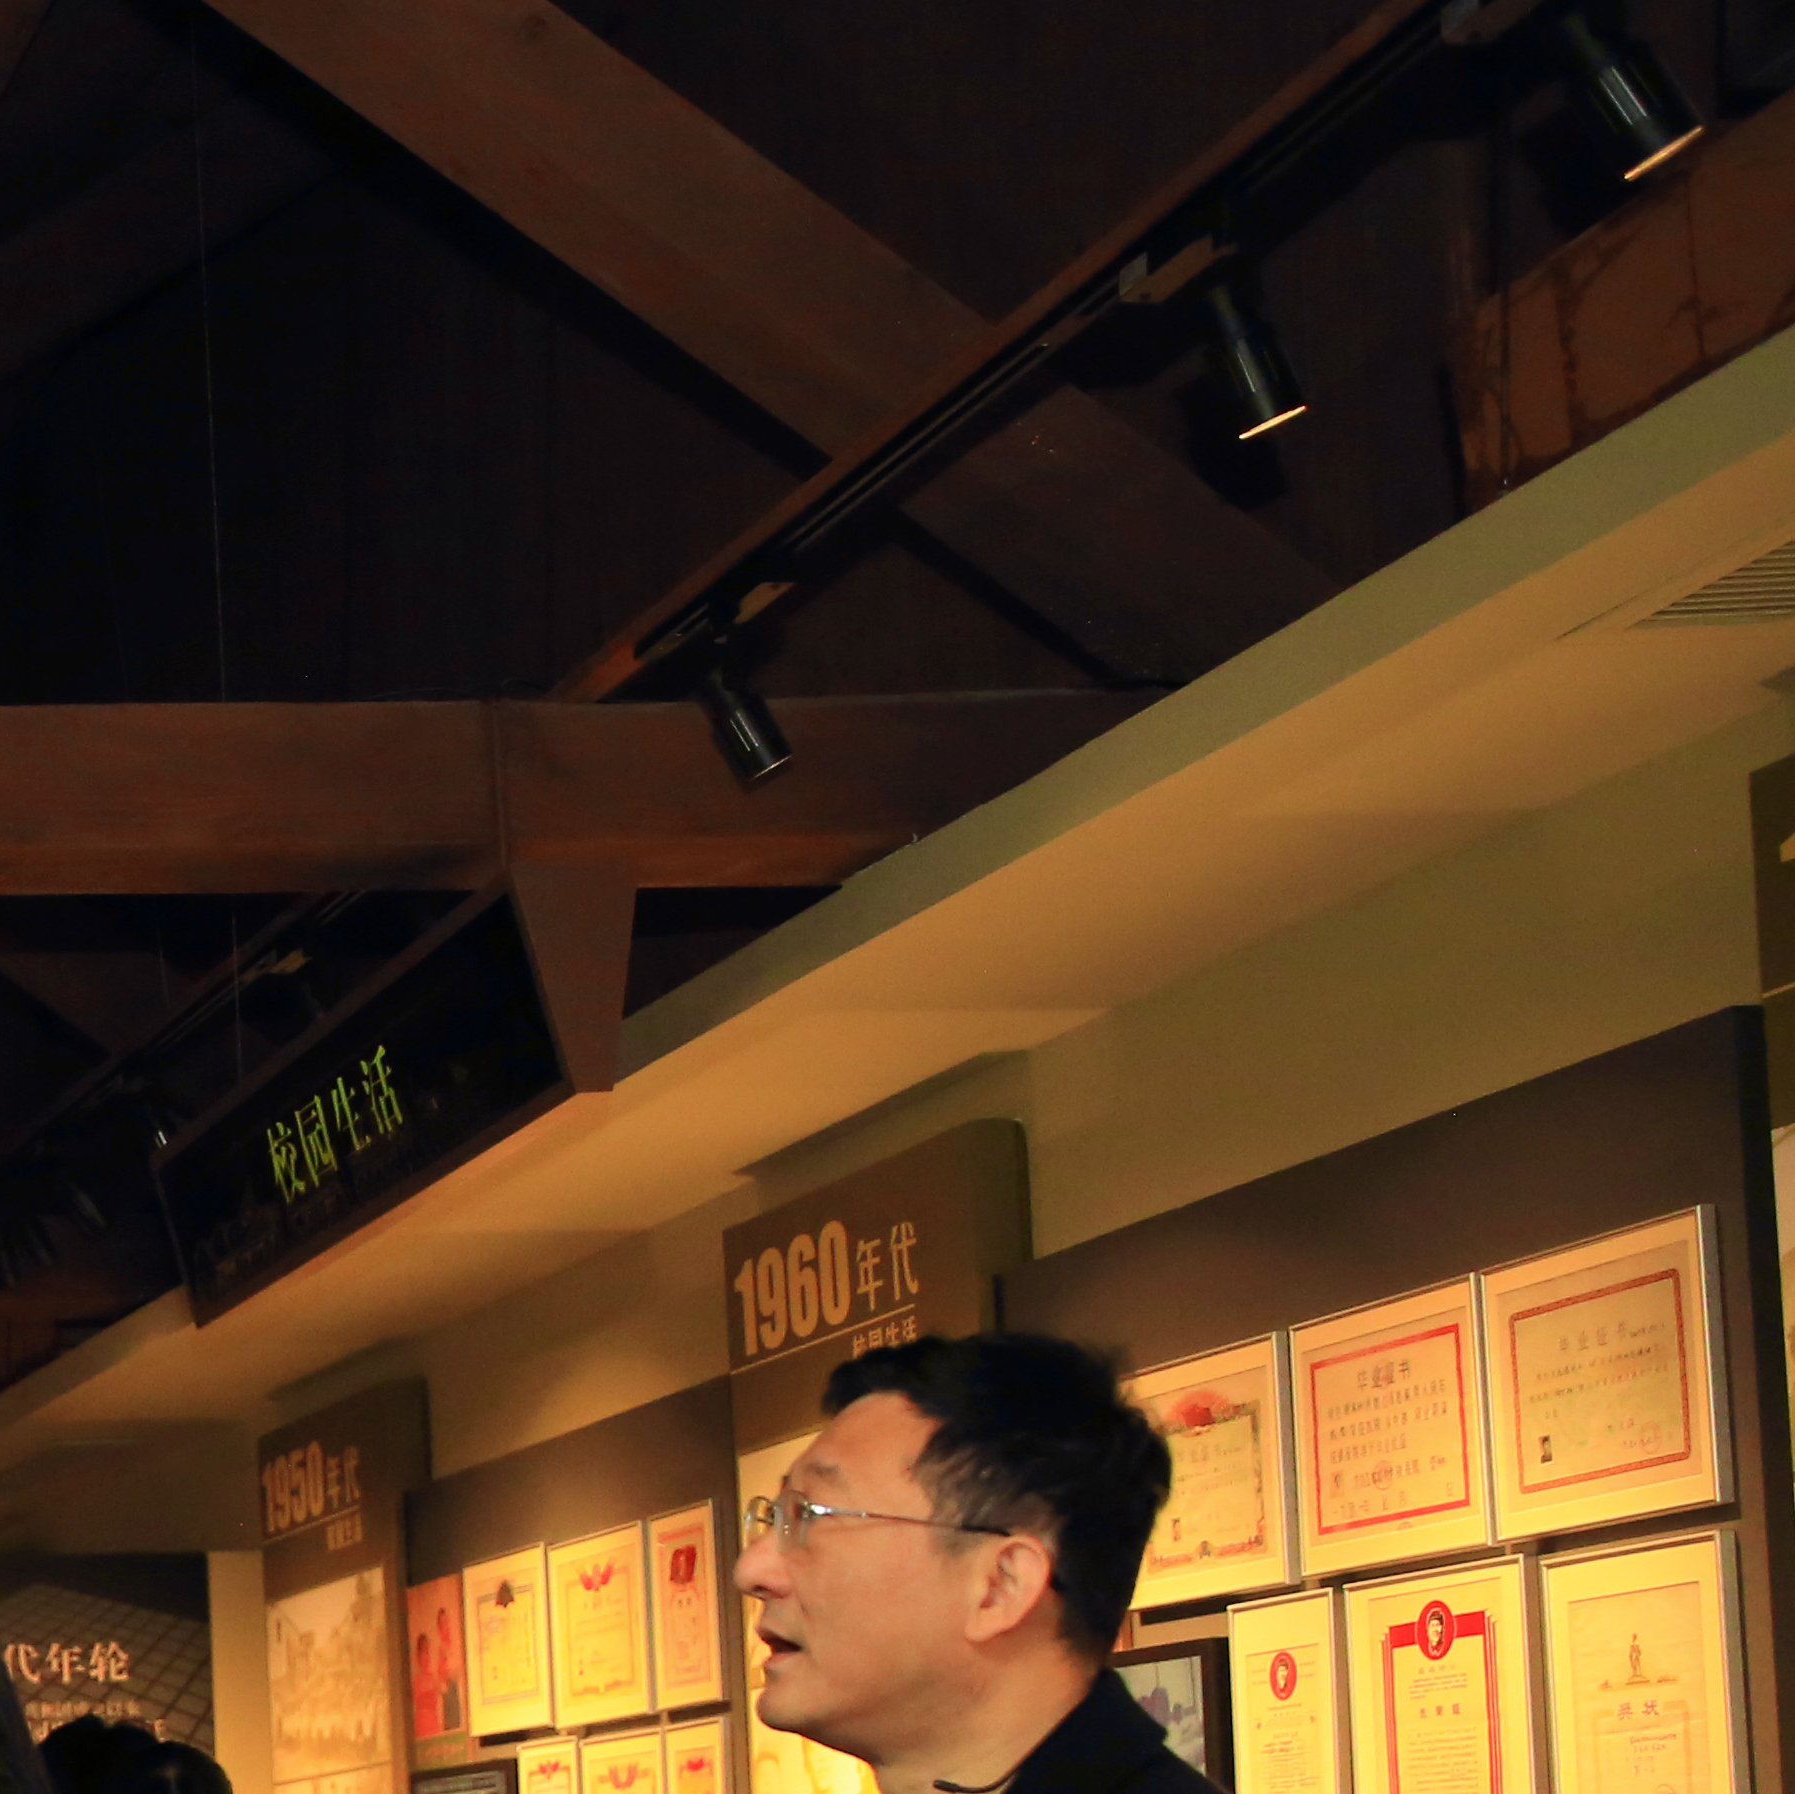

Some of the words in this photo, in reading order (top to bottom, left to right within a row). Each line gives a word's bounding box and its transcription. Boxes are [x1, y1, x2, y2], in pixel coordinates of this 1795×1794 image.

[266, 1045, 404, 1204] 校园生活
[734, 1220, 919, 1356] 1960年代
